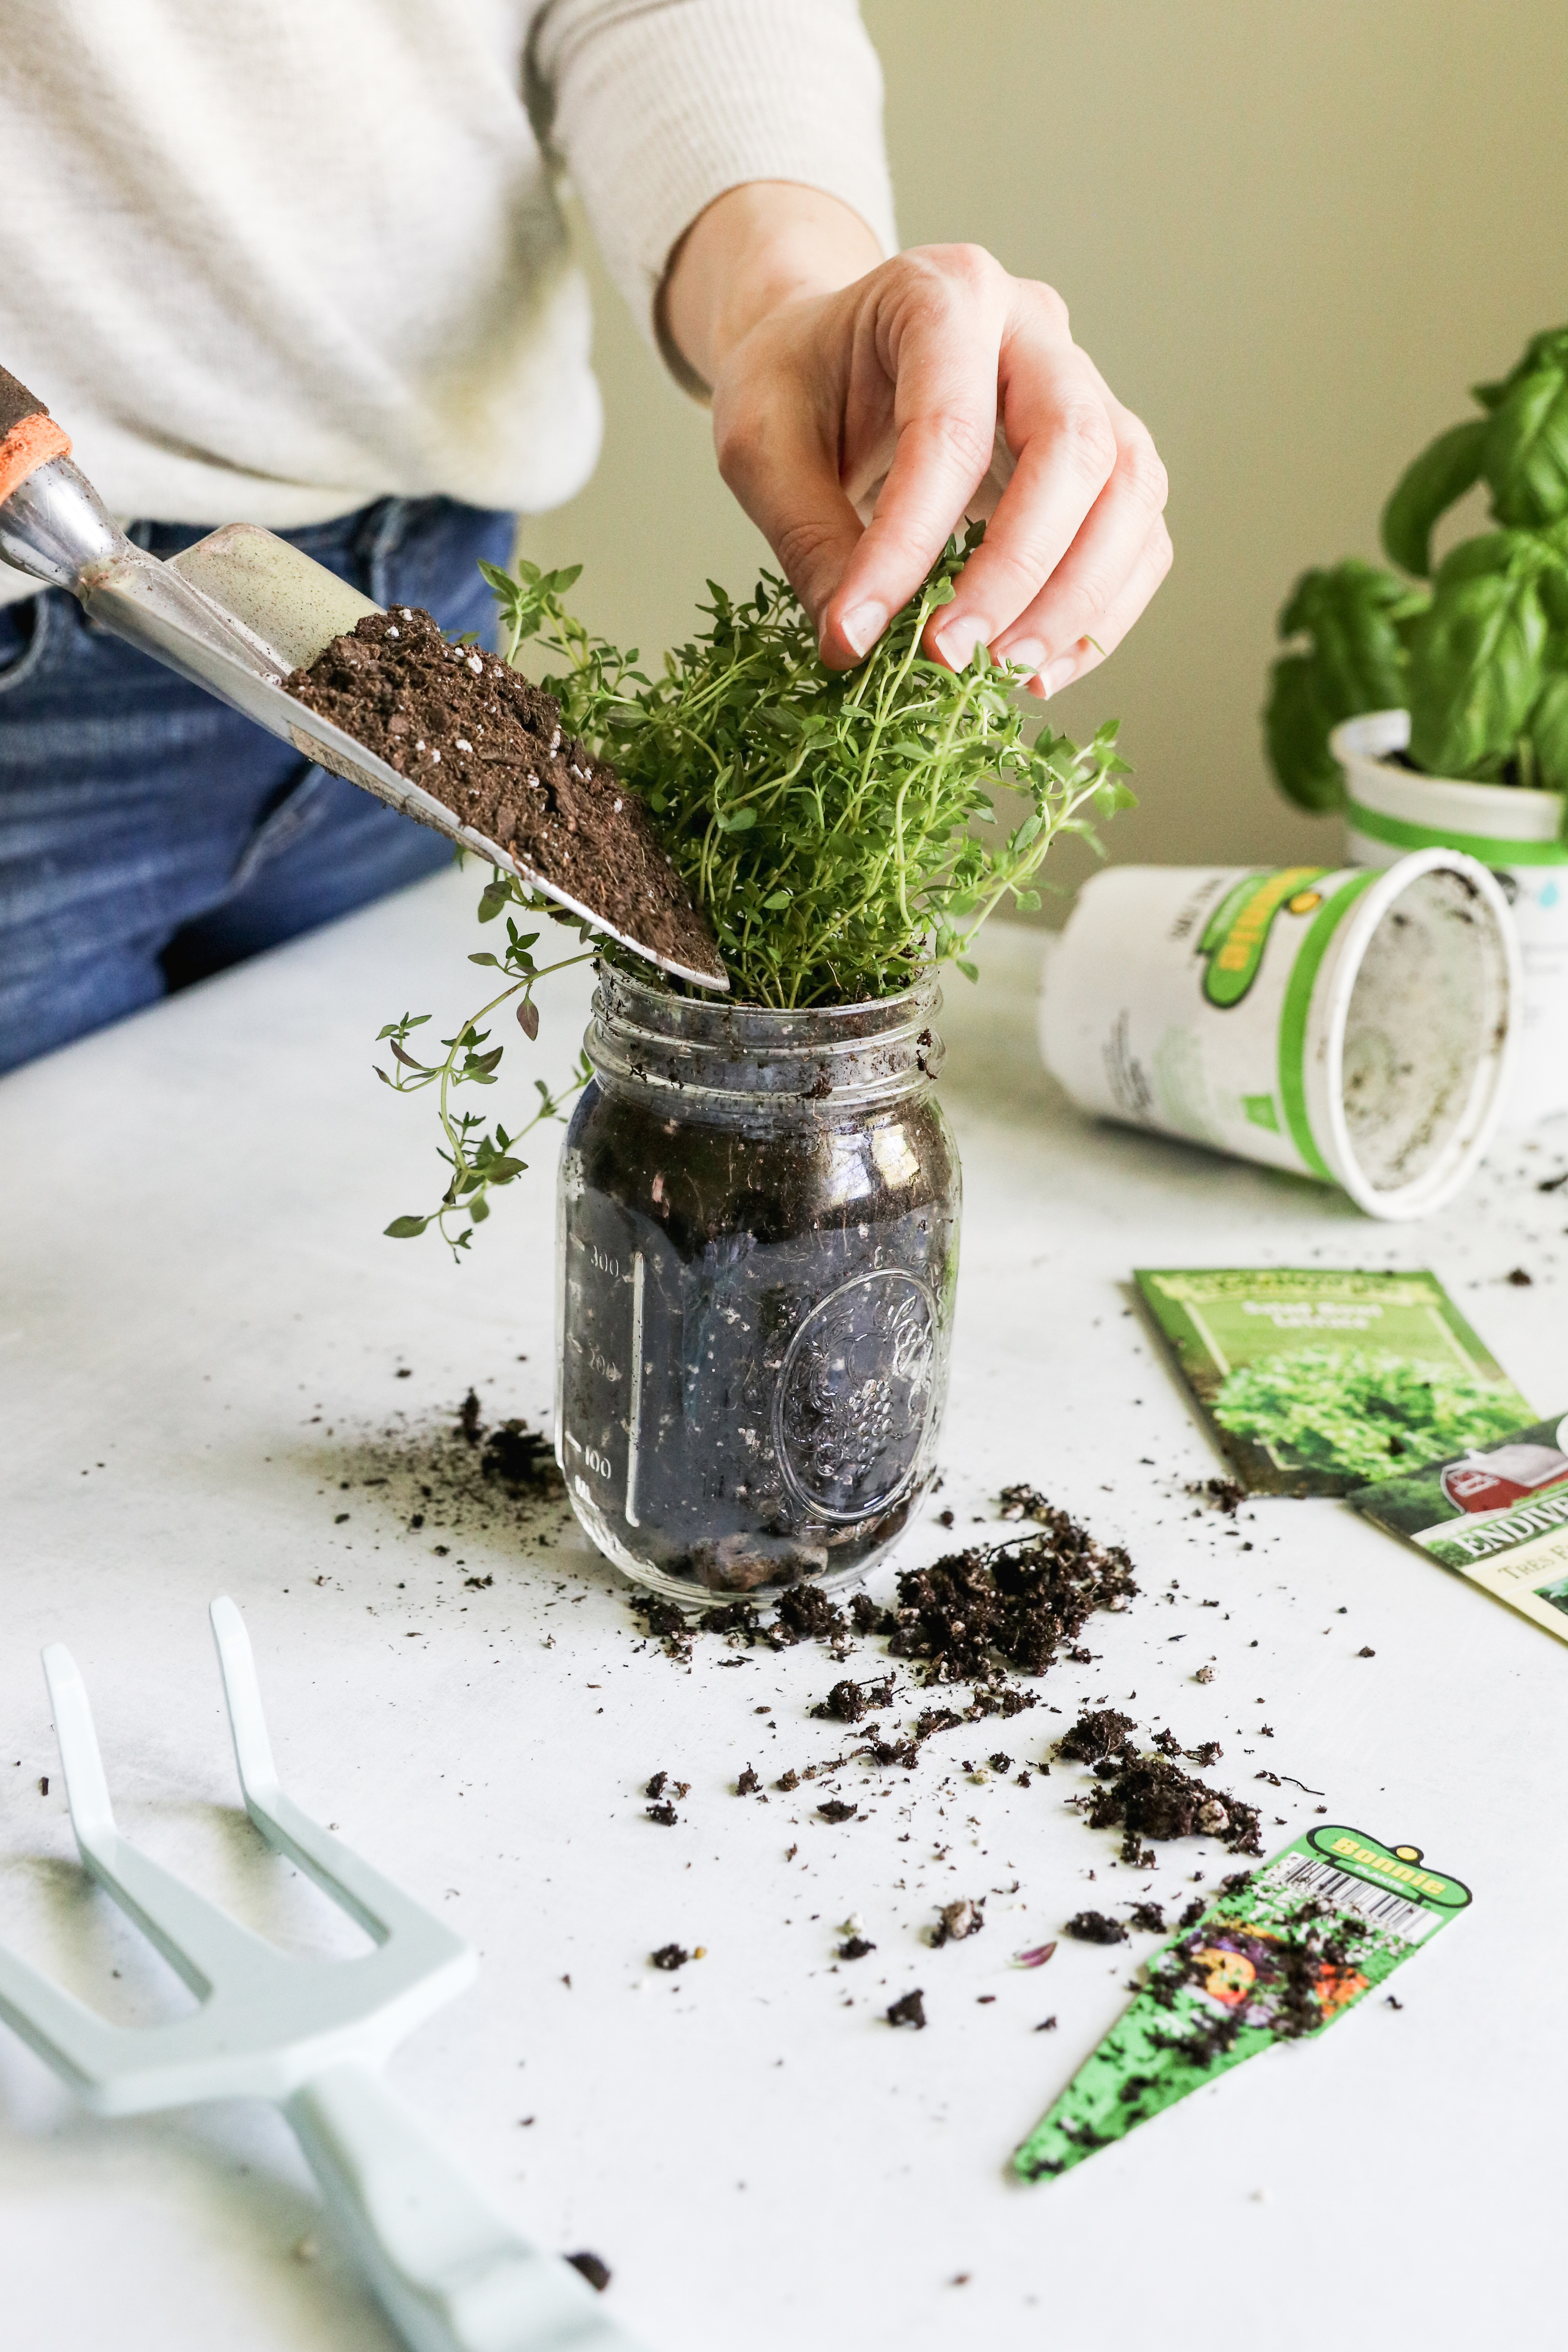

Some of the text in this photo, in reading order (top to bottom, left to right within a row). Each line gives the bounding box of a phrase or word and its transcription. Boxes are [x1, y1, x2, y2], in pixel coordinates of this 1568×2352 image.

[585, 1445, 612, 1479] 100
[1331, 1837, 1446, 1895] Bonnie
[1354, 1864, 1404, 1890] PLANTS
